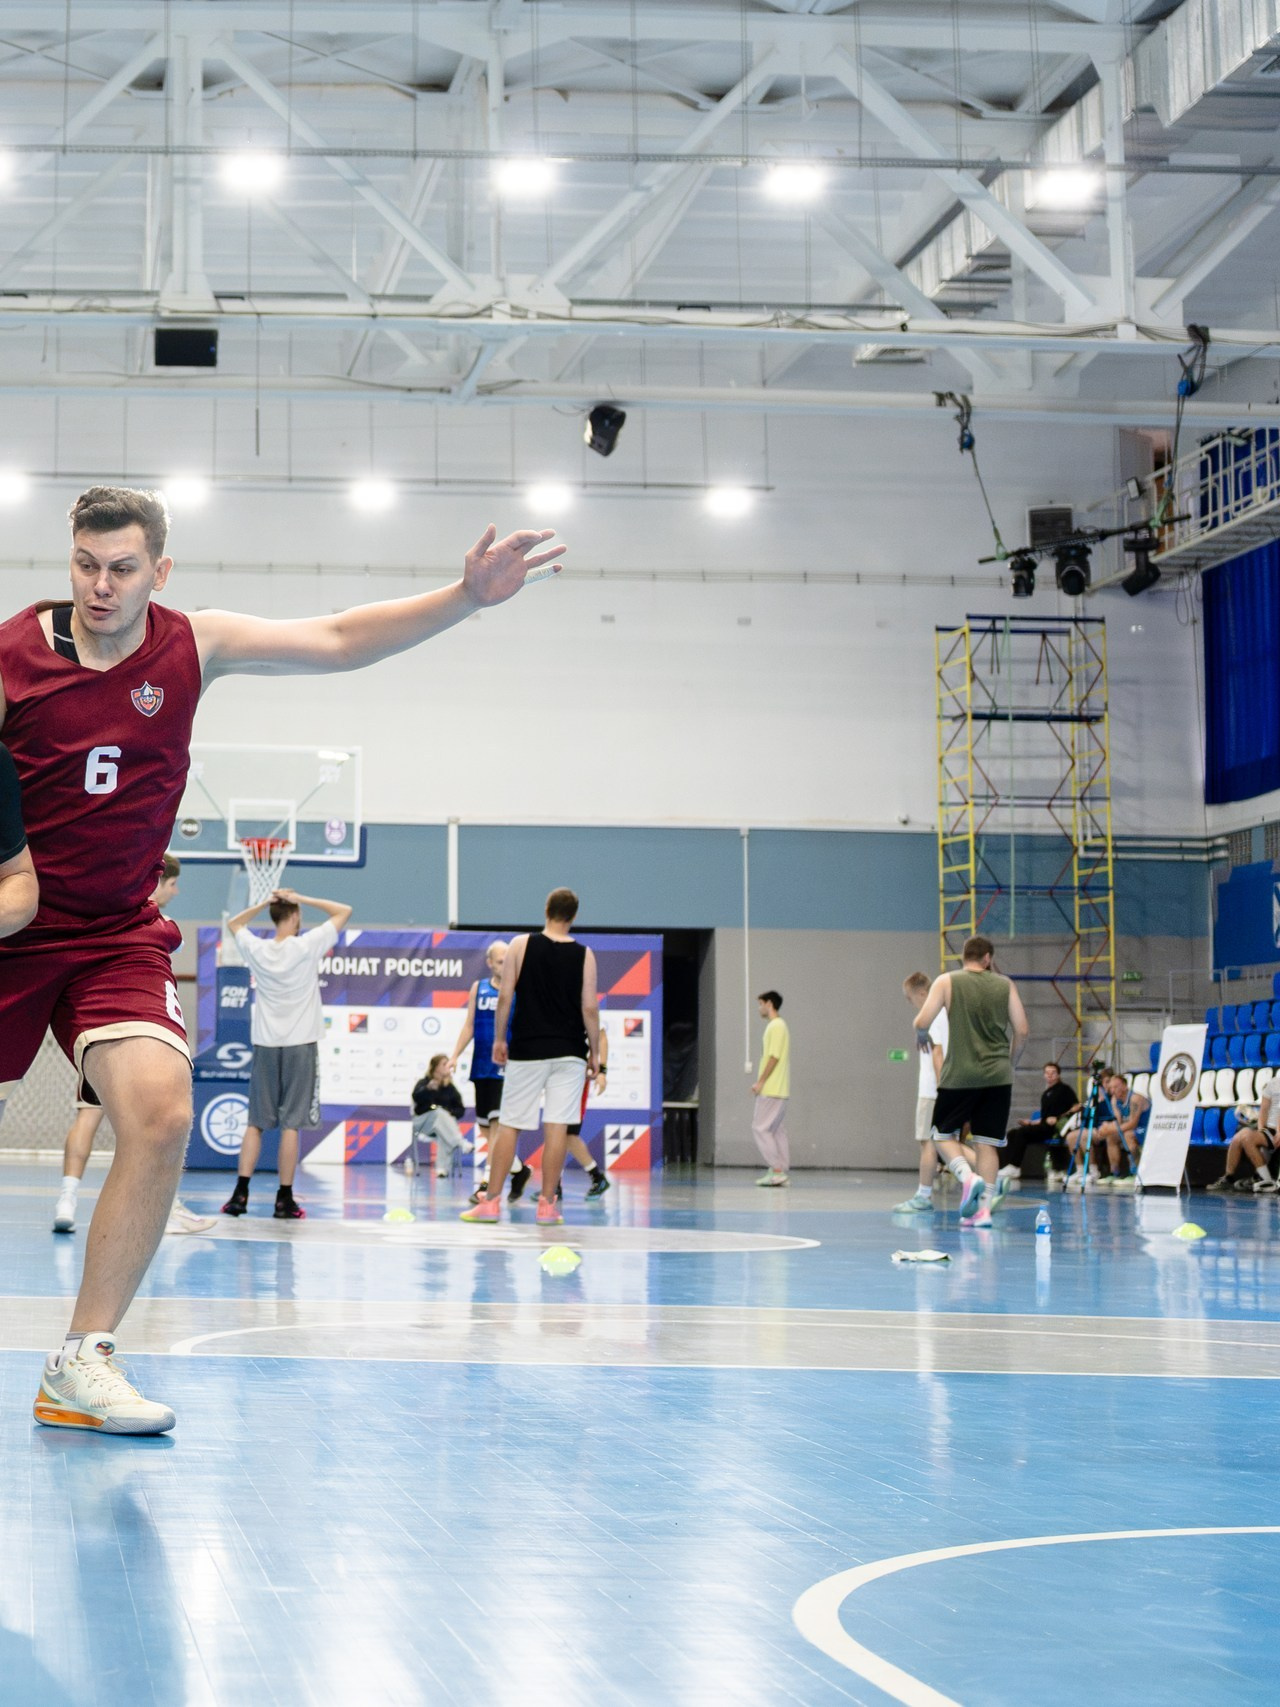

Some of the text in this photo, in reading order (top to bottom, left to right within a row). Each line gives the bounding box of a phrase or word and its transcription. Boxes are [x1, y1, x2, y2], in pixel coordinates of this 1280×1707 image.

[84, 745, 122, 795] 6
[318, 956, 463, 977] ИОНАТ РОССИИ
[477, 996, 498, 1011] US
